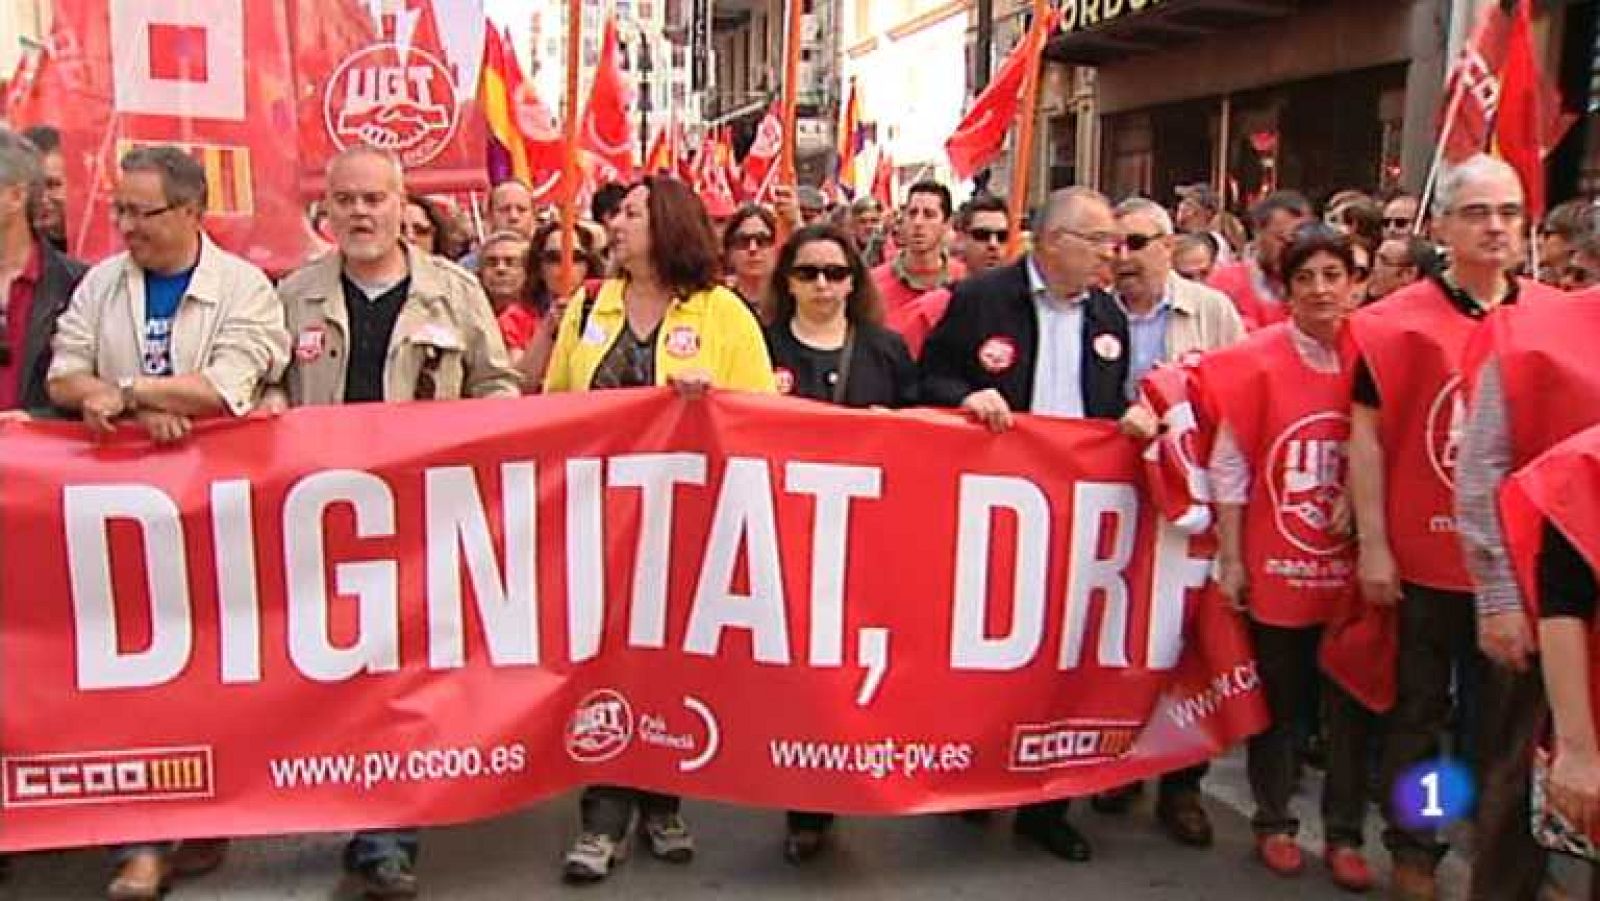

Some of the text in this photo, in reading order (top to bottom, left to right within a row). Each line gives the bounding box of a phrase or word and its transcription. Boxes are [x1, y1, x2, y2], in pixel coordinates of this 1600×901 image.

[346, 66, 434, 113] UGT
[62, 453, 890, 706] DIGNITAT,
[269, 743, 526, 789] www.pv.ccoo.es
[770, 736, 973, 779] www.ugt-pv.es
[1018, 730, 1101, 762] CCOO
[16, 760, 147, 797] CCOO
